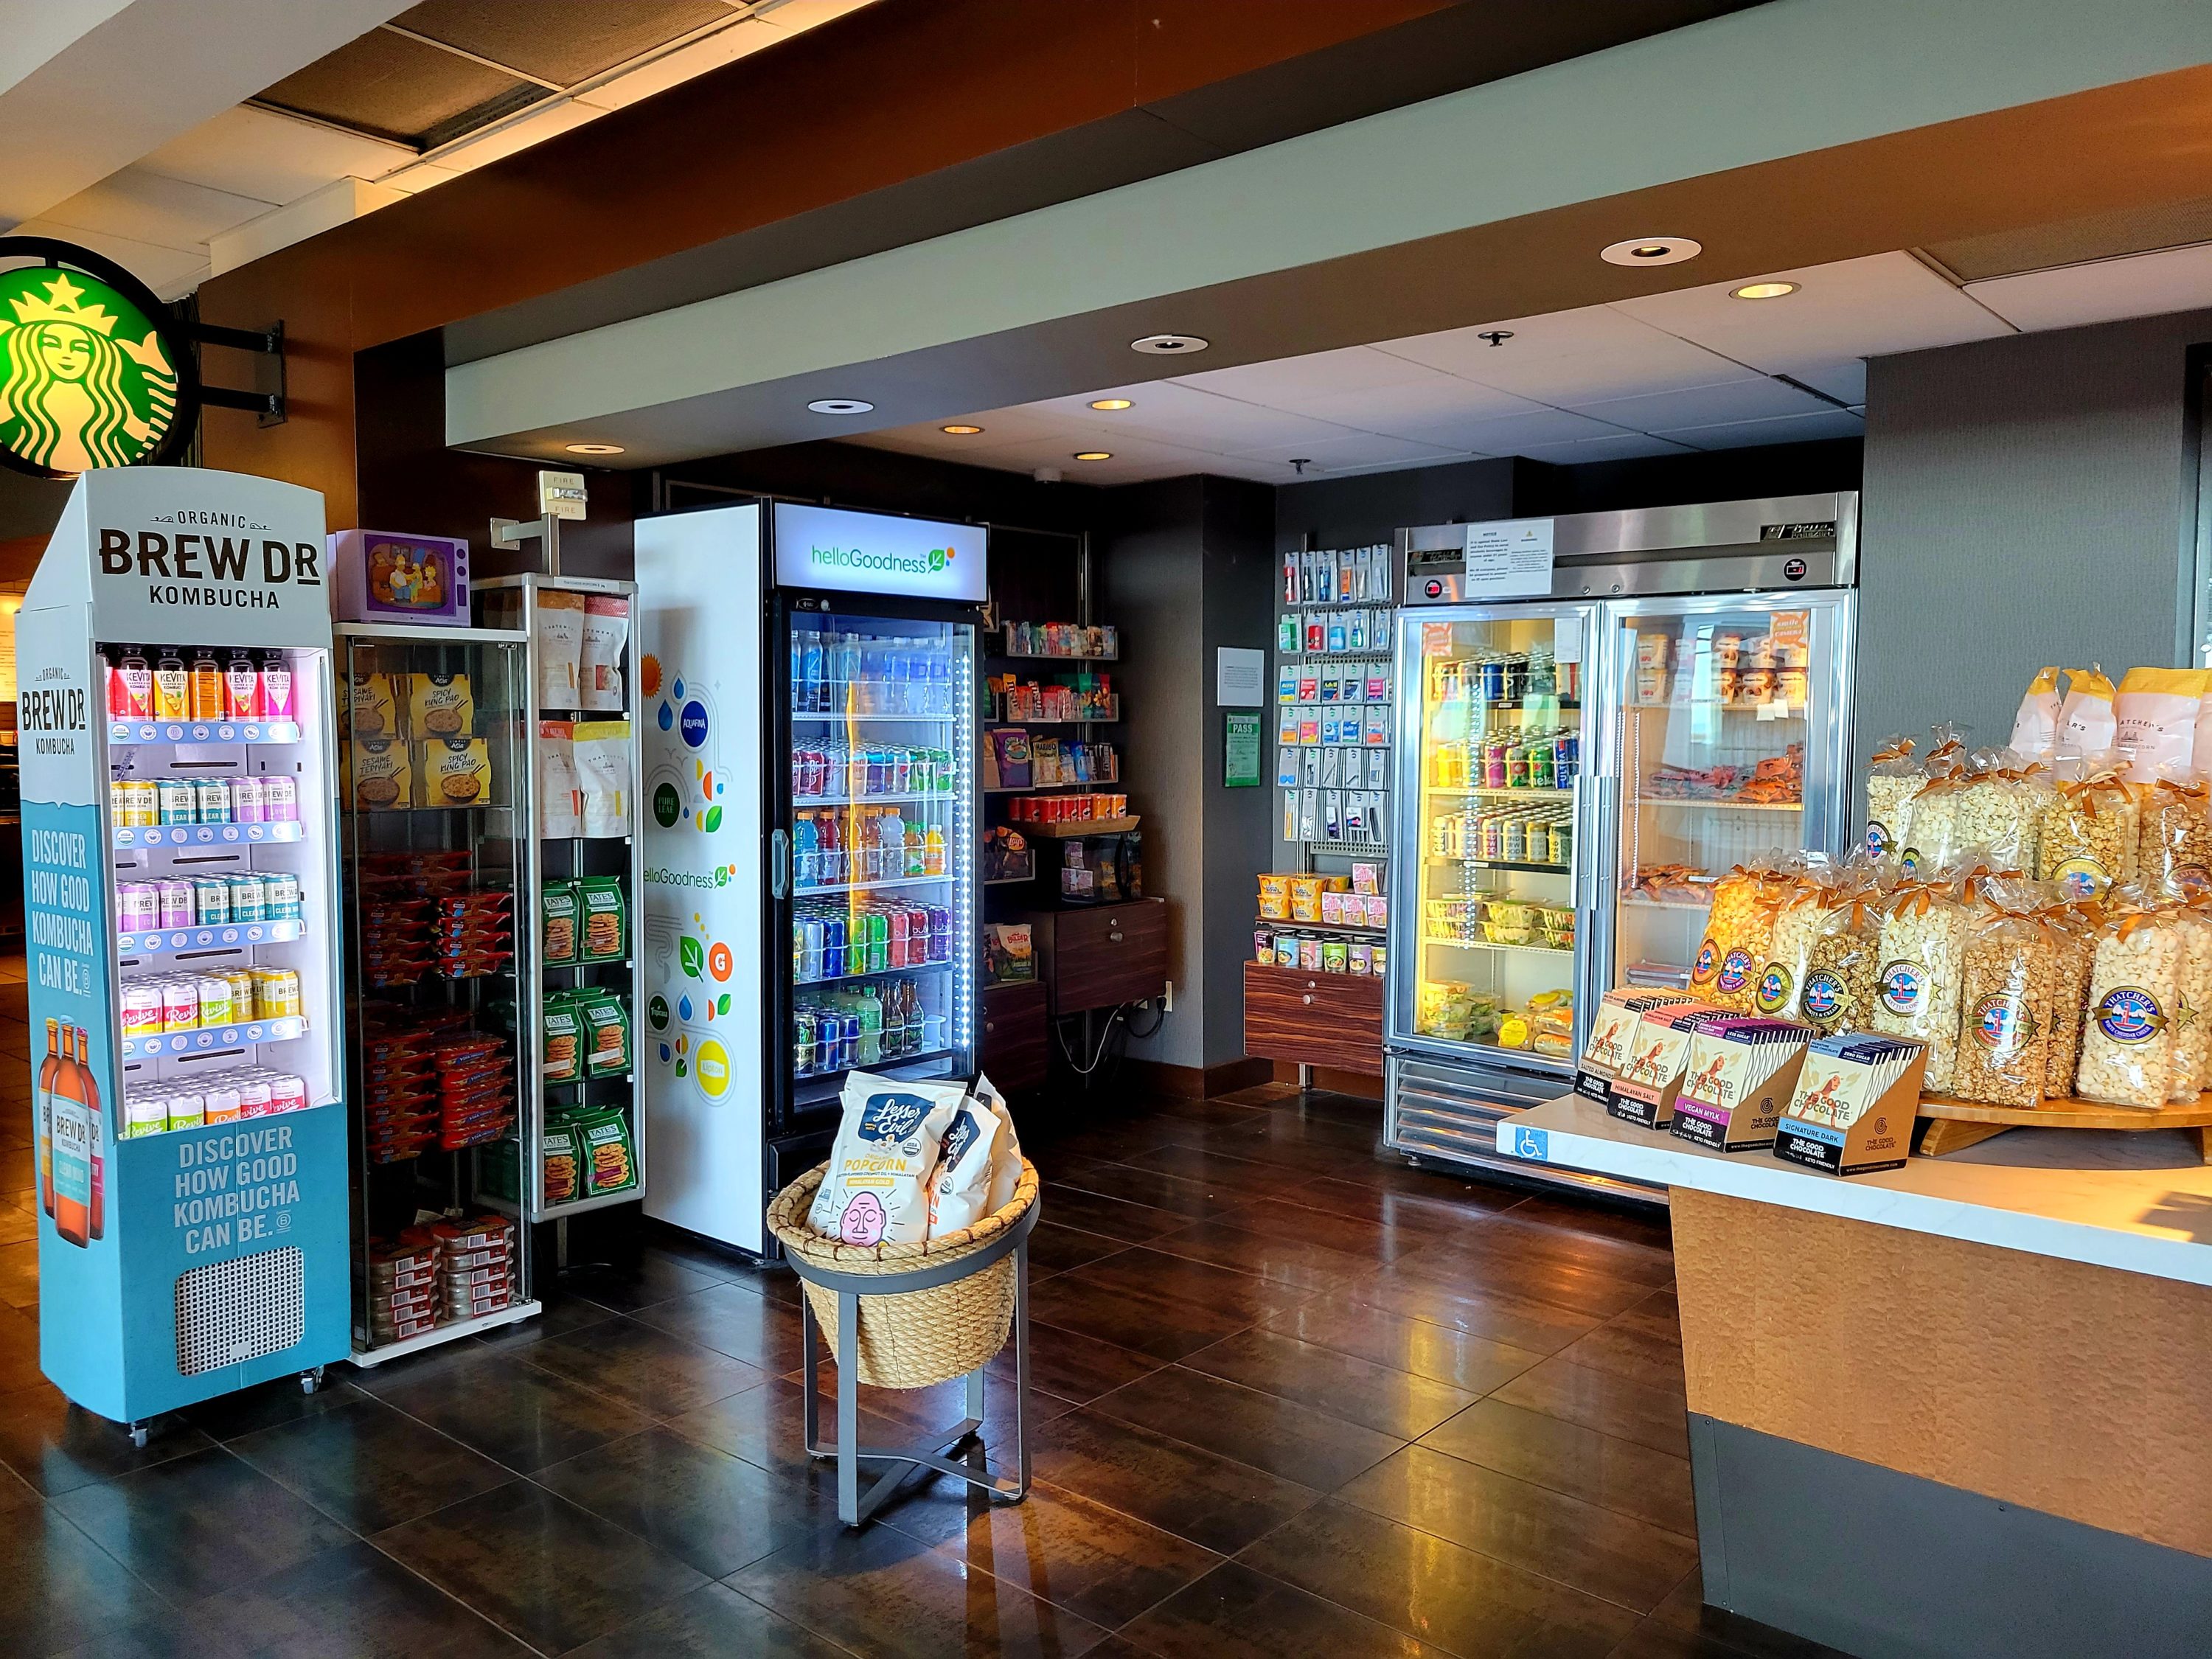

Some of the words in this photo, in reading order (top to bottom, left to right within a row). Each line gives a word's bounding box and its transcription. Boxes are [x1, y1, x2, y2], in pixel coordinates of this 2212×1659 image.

[176, 510, 246, 529] ORGANIC
[98, 528, 250, 582] BREW
[262, 540, 321, 585] DR
[812, 545, 926, 573] helloGoodness
[149, 585, 279, 609] KOMBUCHA
[42, 667, 64, 681] ORGANIC
[342, 693, 375, 703] TRIYAKI
[343, 686, 372, 698] SSAME
[432, 688, 451, 697] SPICY
[425, 698, 443, 706] KUNG
[445, 694, 459, 703] PAO
[22, 688, 68, 731] BREW
[68, 688, 86, 731] DR
[683, 718, 706, 729] AQUAFINA
[1233, 723, 1253, 734] PASS
[2119, 719, 2164, 732] ATCHER'S
[35, 738, 75, 756] KOMBUCHA
[362, 754, 392, 766] SESAME
[440, 764, 459, 773] KUNG
[462, 759, 476, 768] PAO
[448, 754, 468, 763] SPICY
[360, 762, 393, 773] TERIYAKI
[1559, 752, 1567, 782] ULTRA
[658, 796, 675, 805] PURE
[658, 804, 674, 813] LEAF
[31, 829, 86, 869] DISCOVER
[644, 867, 713, 888] elloGoodness
[31, 870, 58, 906] HOW
[60, 873, 90, 912] GOOD
[588, 893, 613, 901] TATE'S
[546, 897, 571, 905] TATE'S
[32, 911, 94, 956] KOMBUCHA
[38, 953, 62, 990] CAN
[64, 958, 83, 995] BE.
[1885, 965, 1924, 983] THATCHER'S
[1806, 973, 1843, 992] THATCHER'S
[2104, 991, 2155, 1012] THATCHER'S
[589, 1007, 615, 1016] TATE'S
[650, 1006, 668, 1018] Tropicana
[1977, 999, 2025, 1020] THATCHS
[546, 1016, 571, 1024] TATE'S
[1589, 1043, 1622, 1061] CHOCOLATE
[1604, 1040, 1623, 1051] GOOD
[702, 1062, 723, 1074] Lipton
[1580, 1063, 1594, 1073] SALTED
[1594, 1068, 1614, 1079] ALMONDS
[1626, 1062, 1668, 1083] CHOCOLATE
[1646, 1060, 1669, 1073] GOOD
[1593, 1078, 1604, 1088] GOOD
[1691, 1071, 1707, 1083] THE
[1708, 1076, 1733, 1089] GOOD
[1583, 1082, 1604, 1094] CHOCOLATE
[1615, 1085, 1642, 1097] HIMALAYAN
[1643, 1092, 1655, 1101] SALT
[1686, 1079, 1734, 1100] CHOCOLATE
[273, 1098, 297, 1112] evive
[1630, 1101, 1644, 1110] GOOD
[1799, 1091, 1819, 1102] THE
[1820, 1096, 1850, 1110] GOOD
[872, 1098, 921, 1122] Lesser
[1618, 1102, 1645, 1116] CHOCOLATE
[1684, 1103, 1703, 1116] VEGAN
[1704, 1109, 1720, 1121] MYLK
[1794, 1099, 1850, 1121] CHOCOLATE
[57, 1114, 77, 1140] BREW
[590, 1125, 617, 1135] TATE'S
[878, 1116, 915, 1135] Evil
[1682, 1121, 1714, 1138] CHOCOLATE
[1685, 1116, 1696, 1126] THE
[1697, 1121, 1713, 1130] GOOD
[1784, 1123, 1819, 1138] SIGNATURE
[1820, 1133, 1839, 1143] DARK
[179, 1126, 293, 1169] DISCOVER
[1704, 1138, 1721, 1148] FRIENDLY
[1790, 1143, 1826, 1158] CHOCOLATE
[1792, 1138, 1805, 1147] THE
[1806, 1142, 1824, 1152] GOOD
[1865, 1143, 1895, 1152] CHOCOLATE
[844, 1158, 907, 1172] POPCORN
[1816, 1160, 1835, 1169] FRIENDLY
[175, 1164, 234, 1198] HOW
[237, 1152, 298, 1186] GOOD
[174, 1180, 301, 1228] KOMBUCHA
[185, 1222, 231, 1254] CAN
[238, 1214, 274, 1242] BE.
